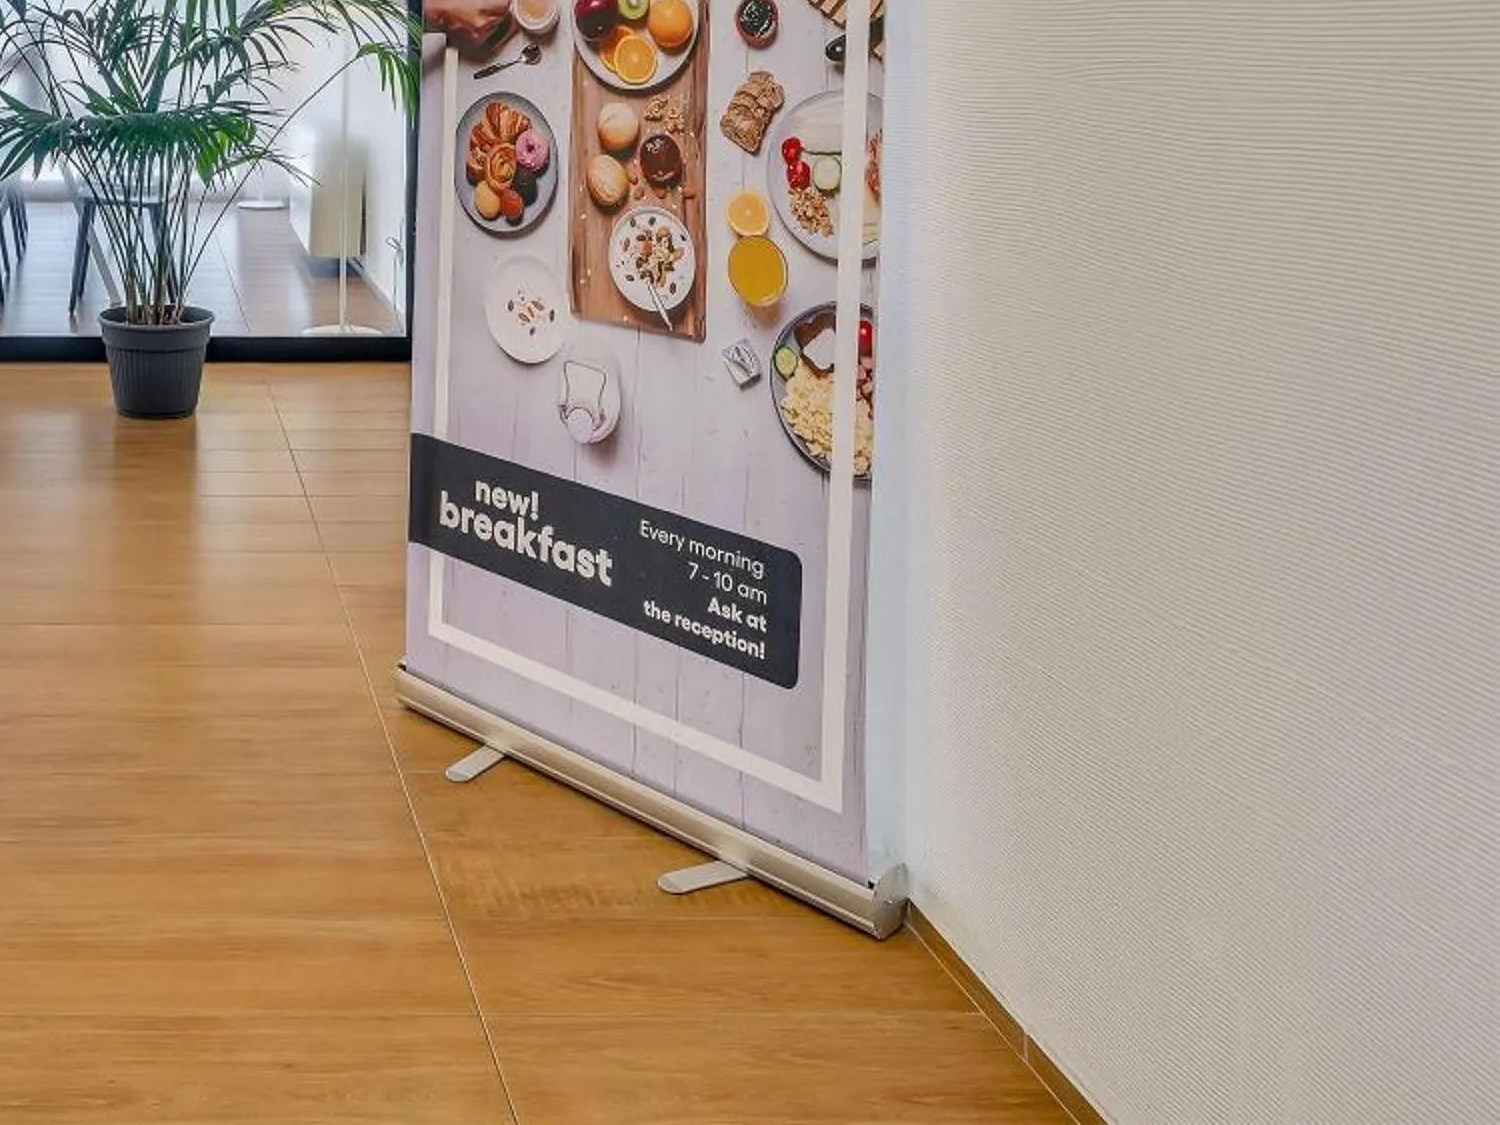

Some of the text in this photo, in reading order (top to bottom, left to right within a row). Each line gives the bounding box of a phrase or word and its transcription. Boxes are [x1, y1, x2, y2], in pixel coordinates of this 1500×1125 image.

[475, 479, 540, 521] new!
[439, 491, 614, 588] breakfast
[639, 518, 765, 580] Every morning
[687, 561, 699, 580] 7
[713, 571, 733, 592] 10
[737, 583, 767, 606] am
[643, 600, 766, 660] the reception!
[707, 596, 768, 633] Ask at
